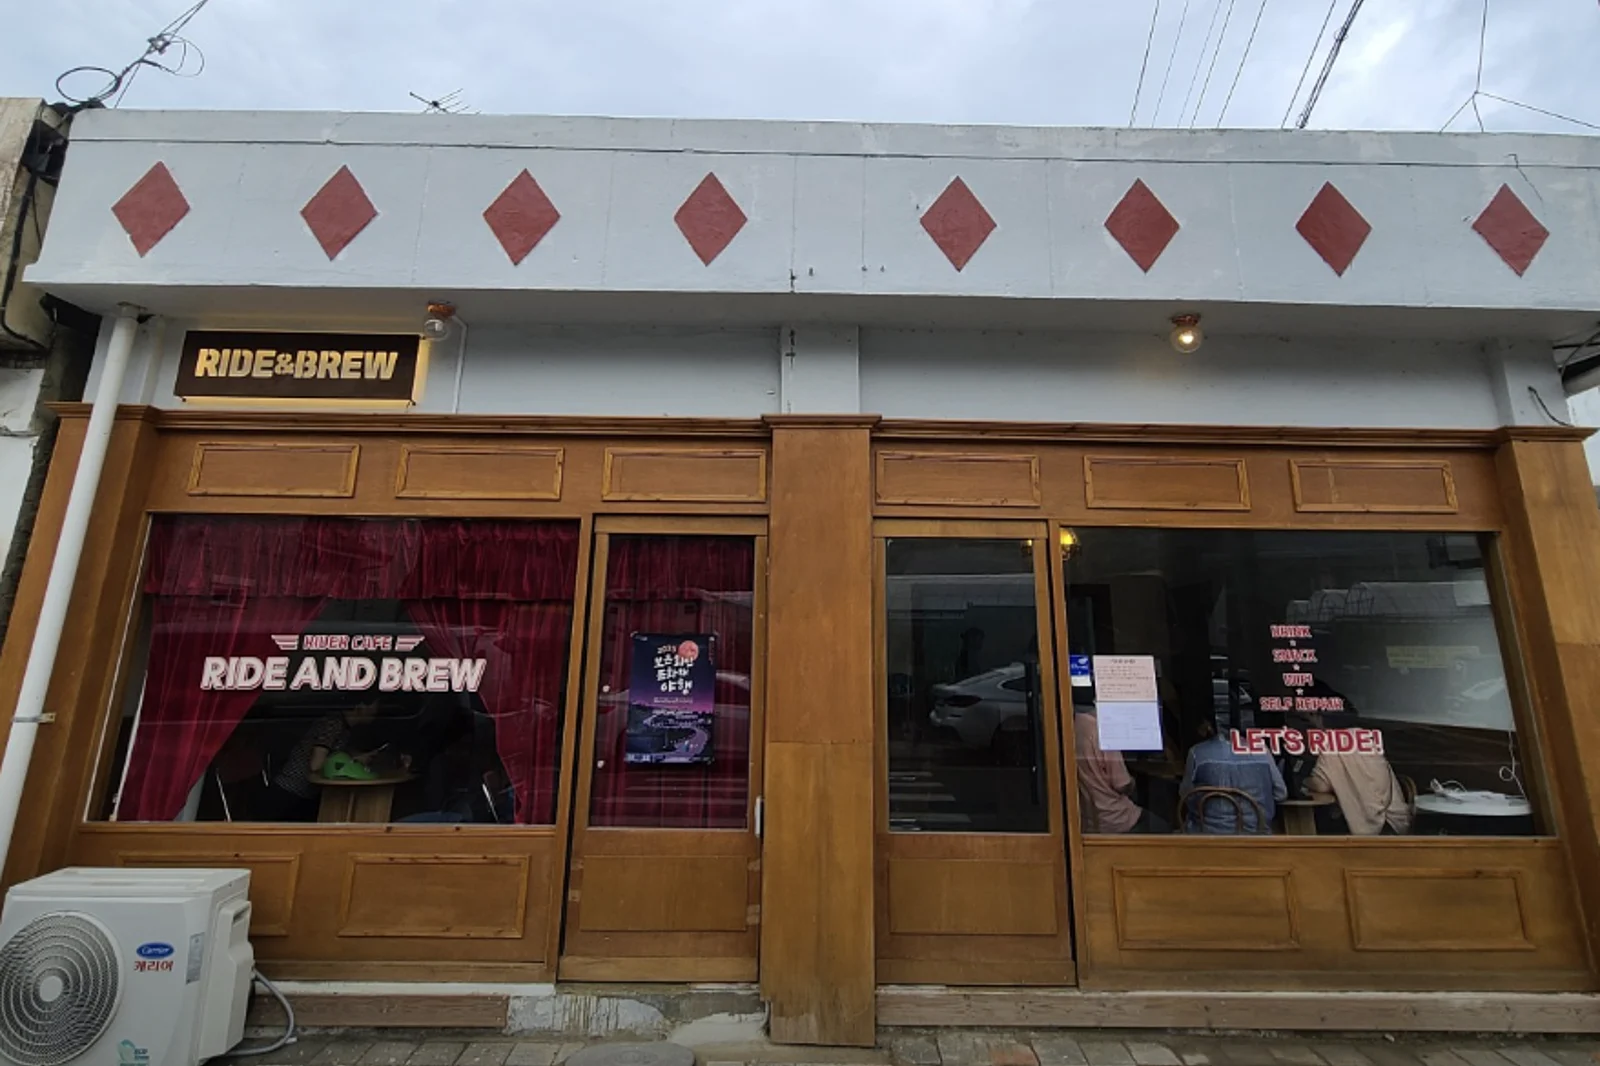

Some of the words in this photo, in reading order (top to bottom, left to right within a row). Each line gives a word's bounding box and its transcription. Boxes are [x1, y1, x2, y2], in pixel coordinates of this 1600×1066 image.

[194, 348, 399, 380] RIDE&BREW
[351, 635, 393, 651] CAFE
[1272, 649, 1318, 663] SNACK
[200, 656, 290, 691] RIDE
[289, 656, 378, 691] AND
[378, 657, 488, 693] BREW
[1259, 697, 1293, 711] SELF
[1295, 697, 1345, 711] REPAIR
[1230, 725, 1306, 755] LET'S
[1307, 727, 1384, 755] RIDE!
